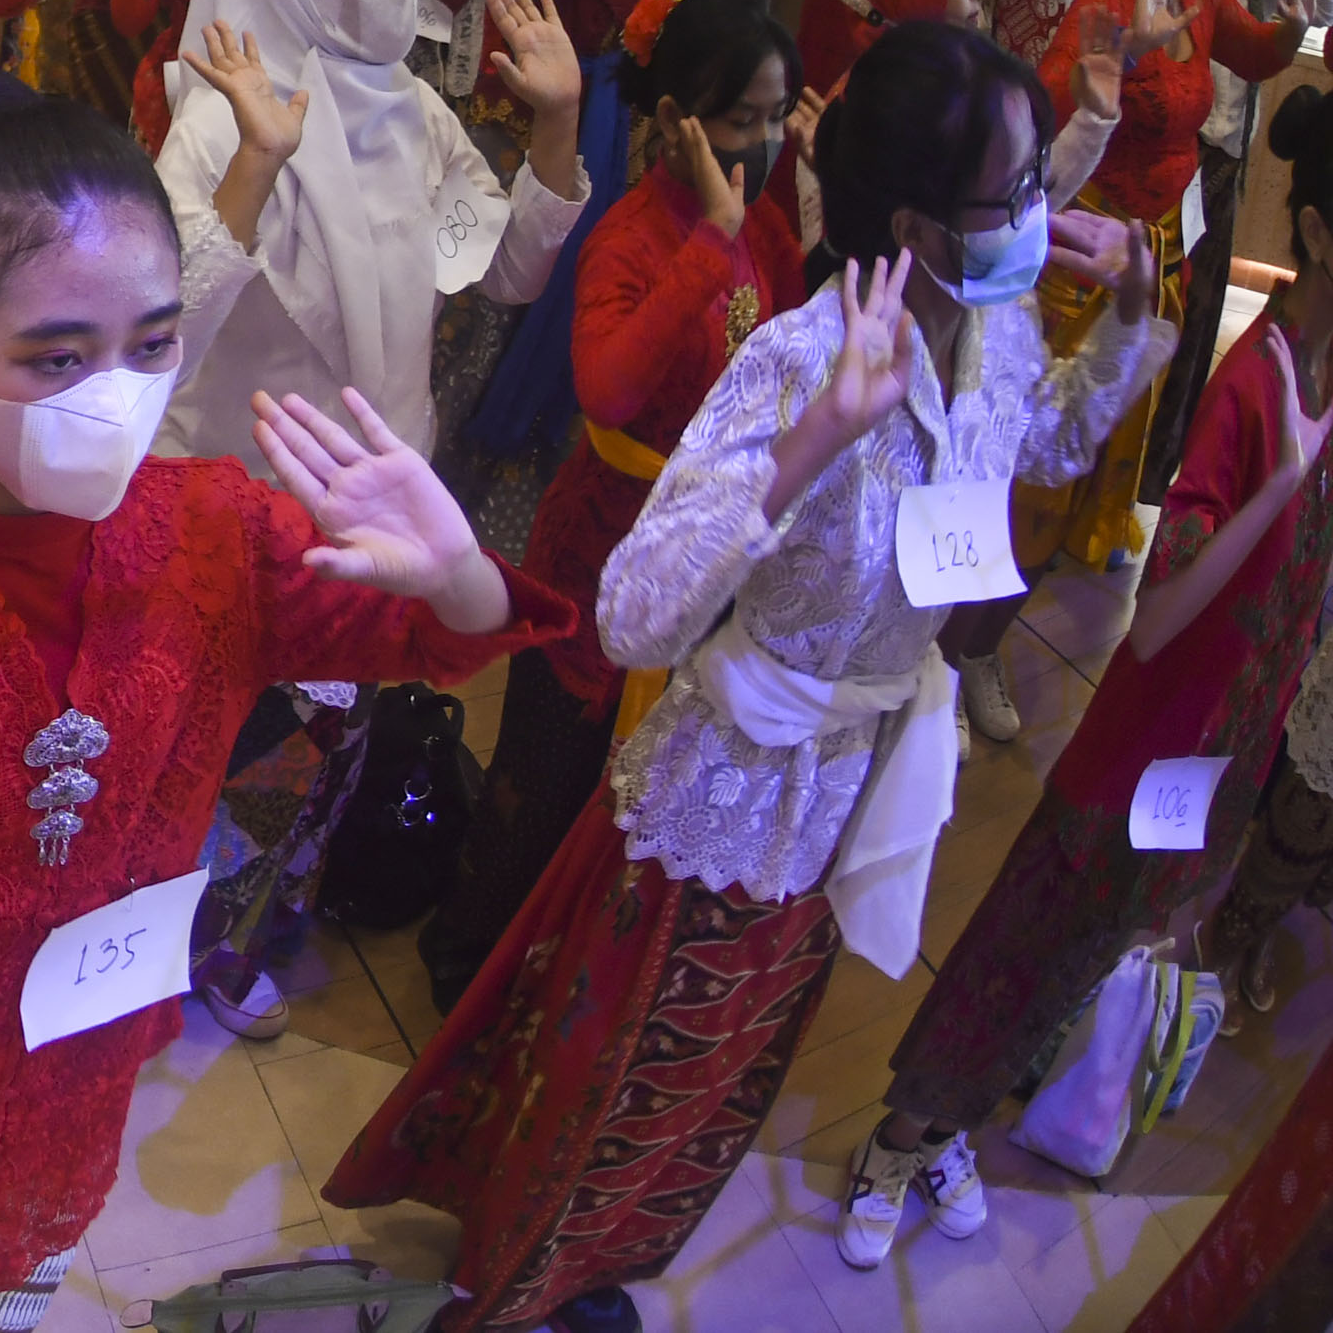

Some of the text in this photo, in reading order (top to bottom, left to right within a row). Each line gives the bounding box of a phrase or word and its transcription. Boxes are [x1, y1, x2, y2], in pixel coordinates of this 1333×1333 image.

[436, 199, 478, 259] 080
[932, 530, 979, 572] 128
[1152, 785, 1191, 820] 106
[73, 927, 147, 986] 135
